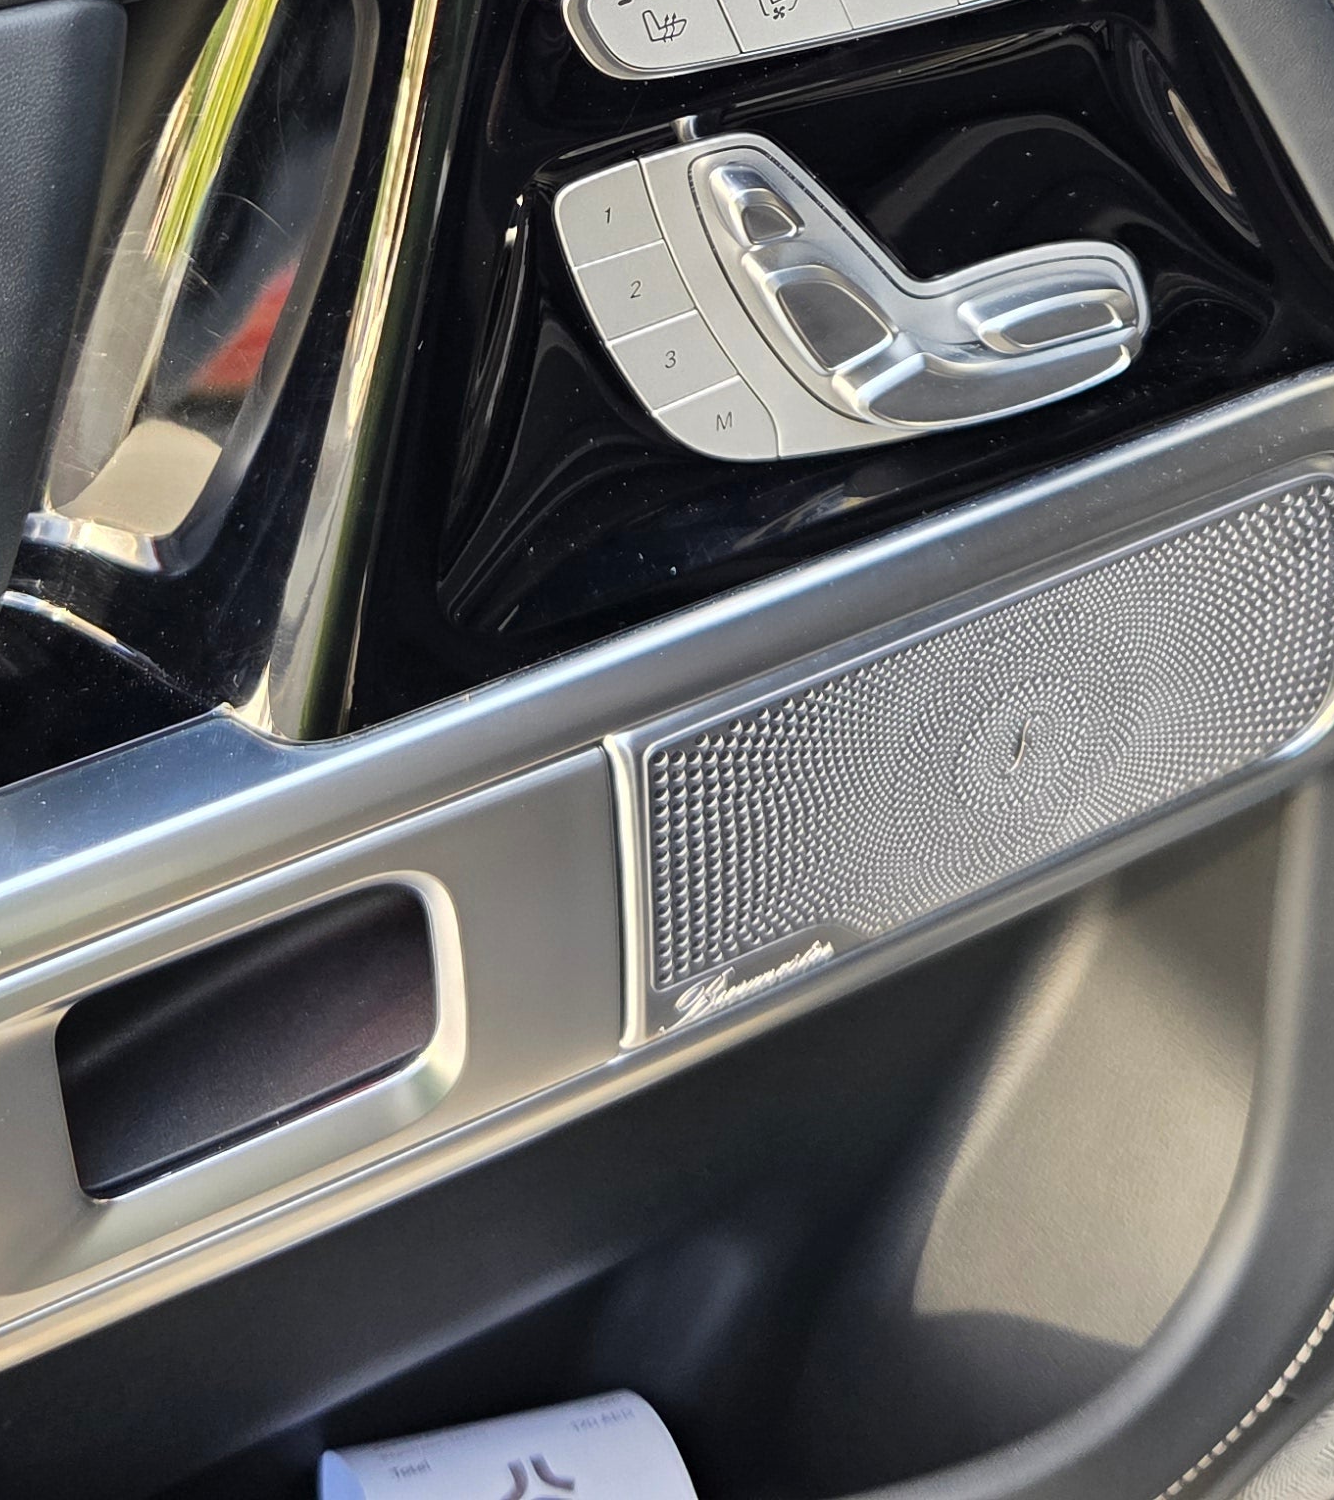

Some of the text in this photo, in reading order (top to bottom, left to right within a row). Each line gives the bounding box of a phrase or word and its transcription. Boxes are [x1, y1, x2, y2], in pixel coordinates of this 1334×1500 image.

[604, 207, 612, 224] 1
[629, 280, 642, 299] 2
[664, 350, 677, 369] 3
[716, 411, 734, 431] M
